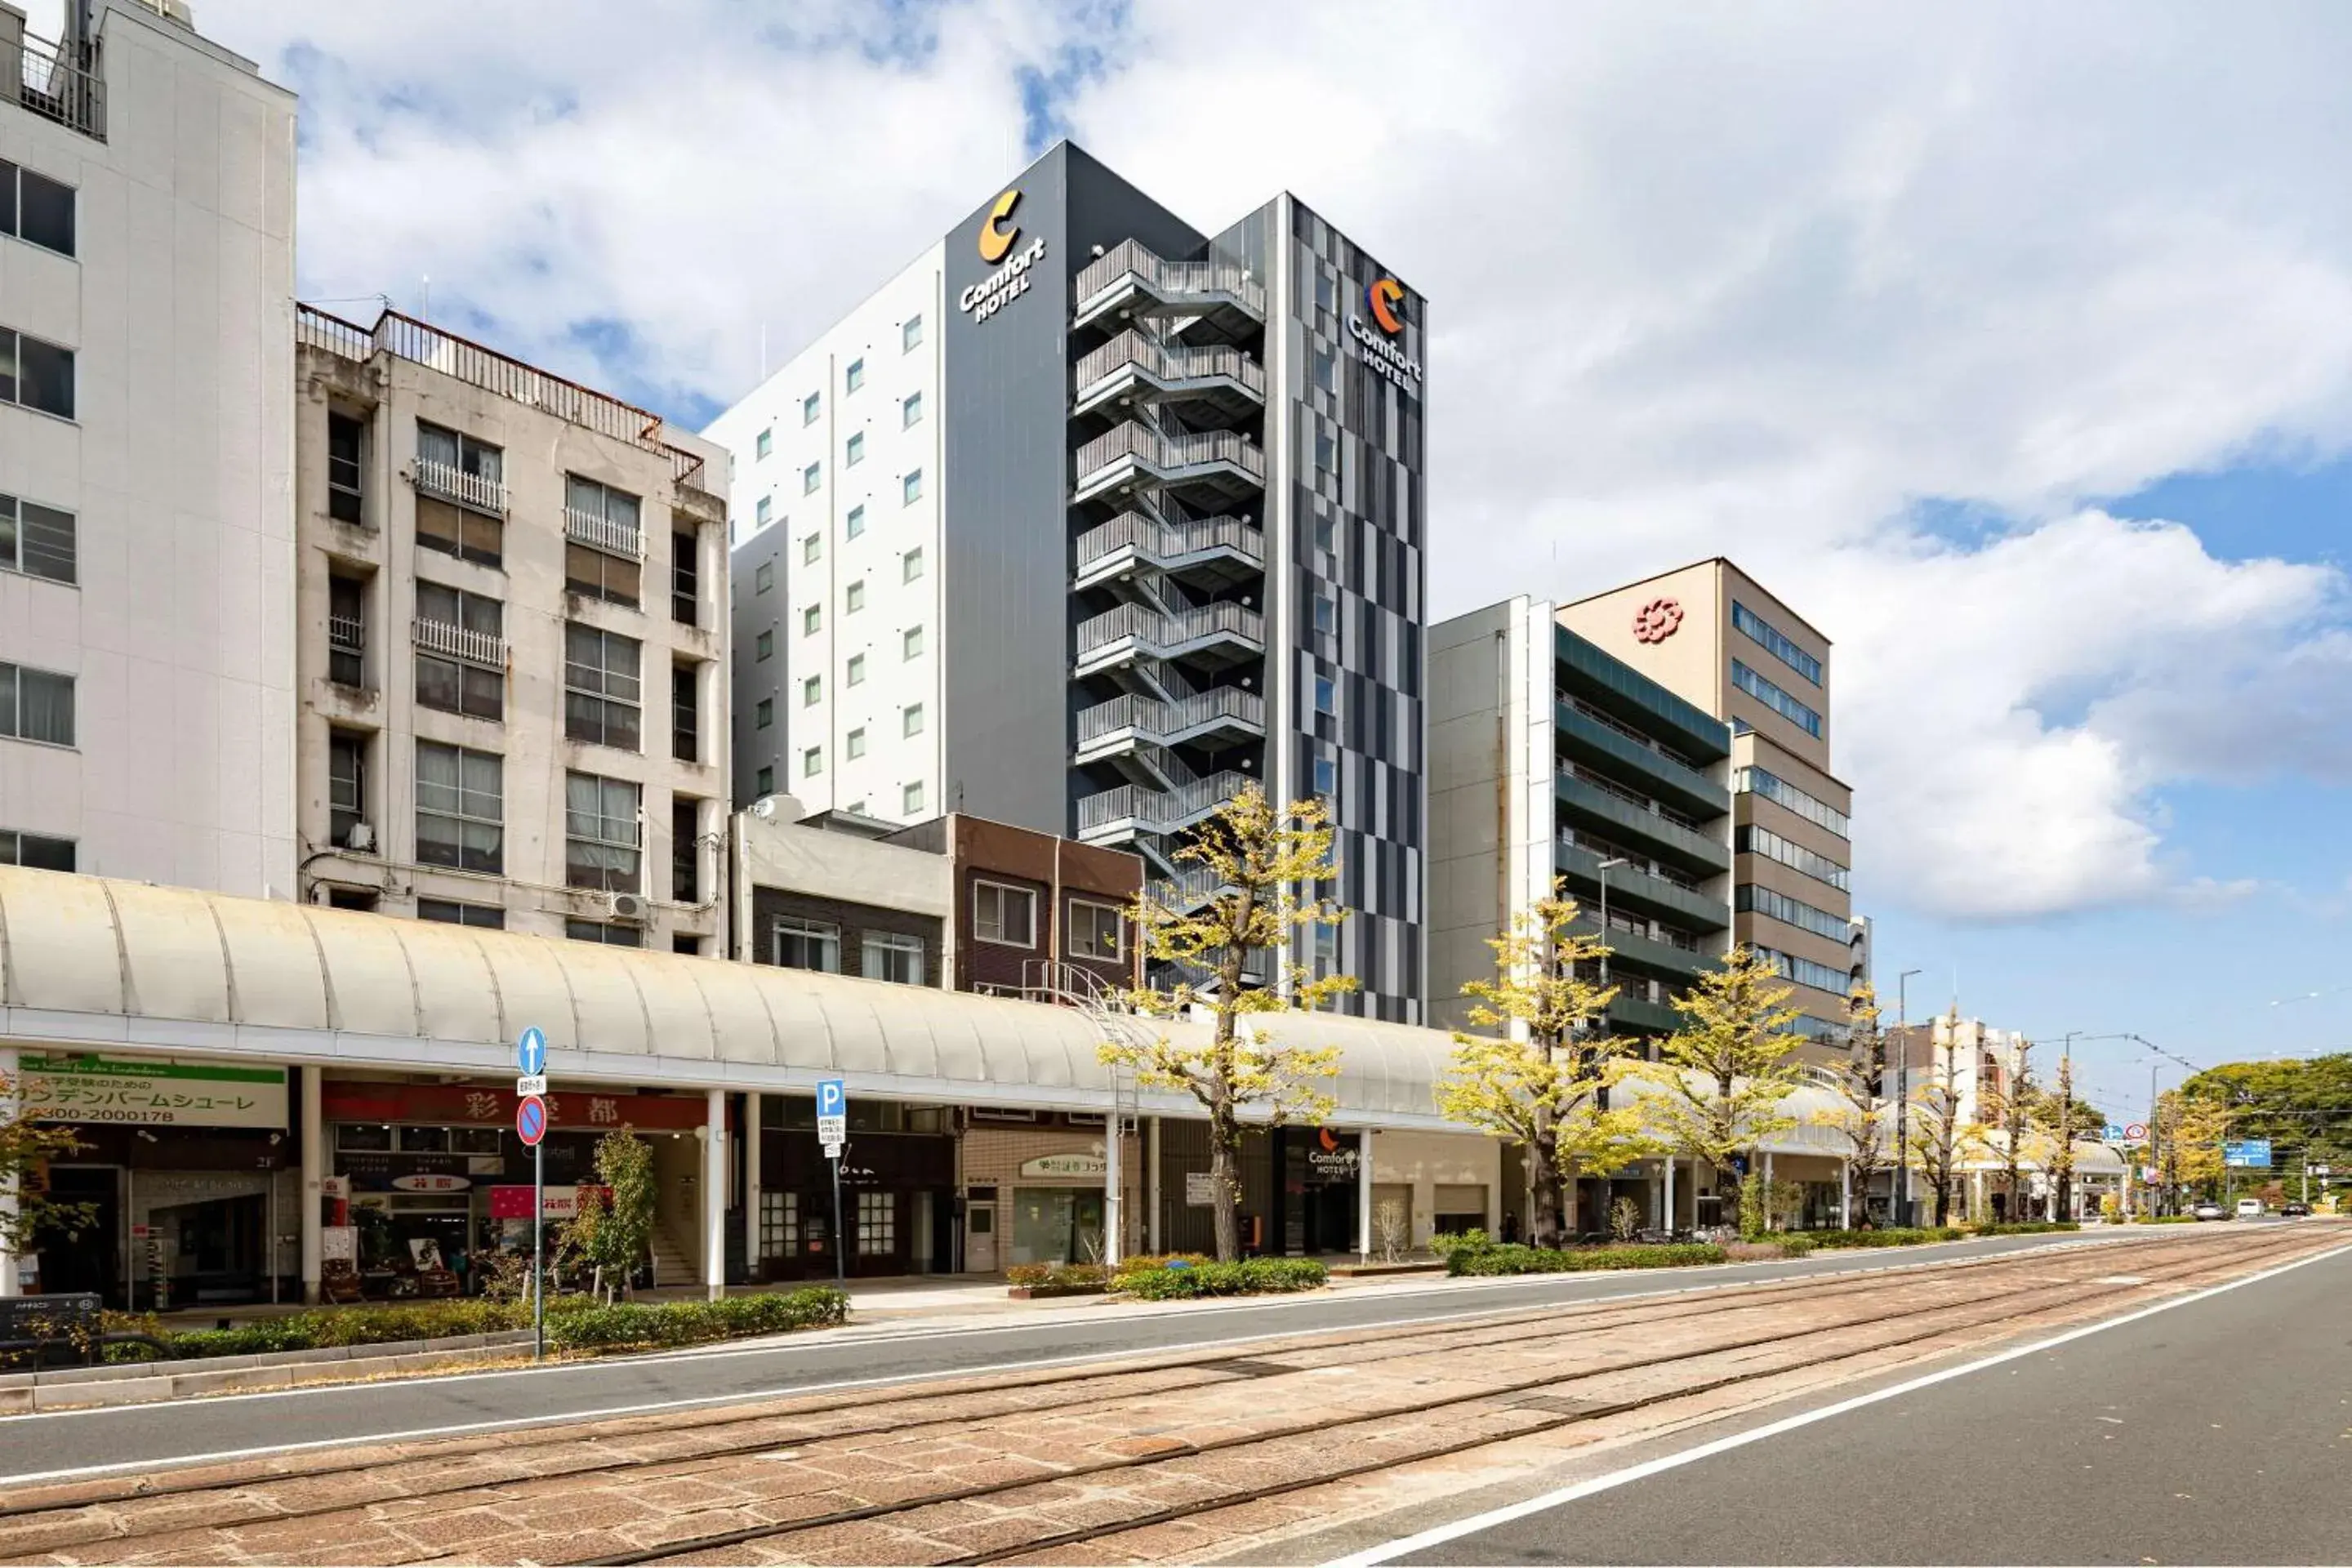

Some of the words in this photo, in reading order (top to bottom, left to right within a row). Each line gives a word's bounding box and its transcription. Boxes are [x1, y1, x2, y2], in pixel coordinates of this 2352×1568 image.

[960, 237, 1044, 312] Comfort
[975, 274, 1029, 324] HOTEL
[1348, 314, 1421, 381] Comfort
[1363, 347, 1410, 392] HOTEL
[823, 1084, 840, 1114] P
[1308, 1152, 1349, 1164] Comfor
